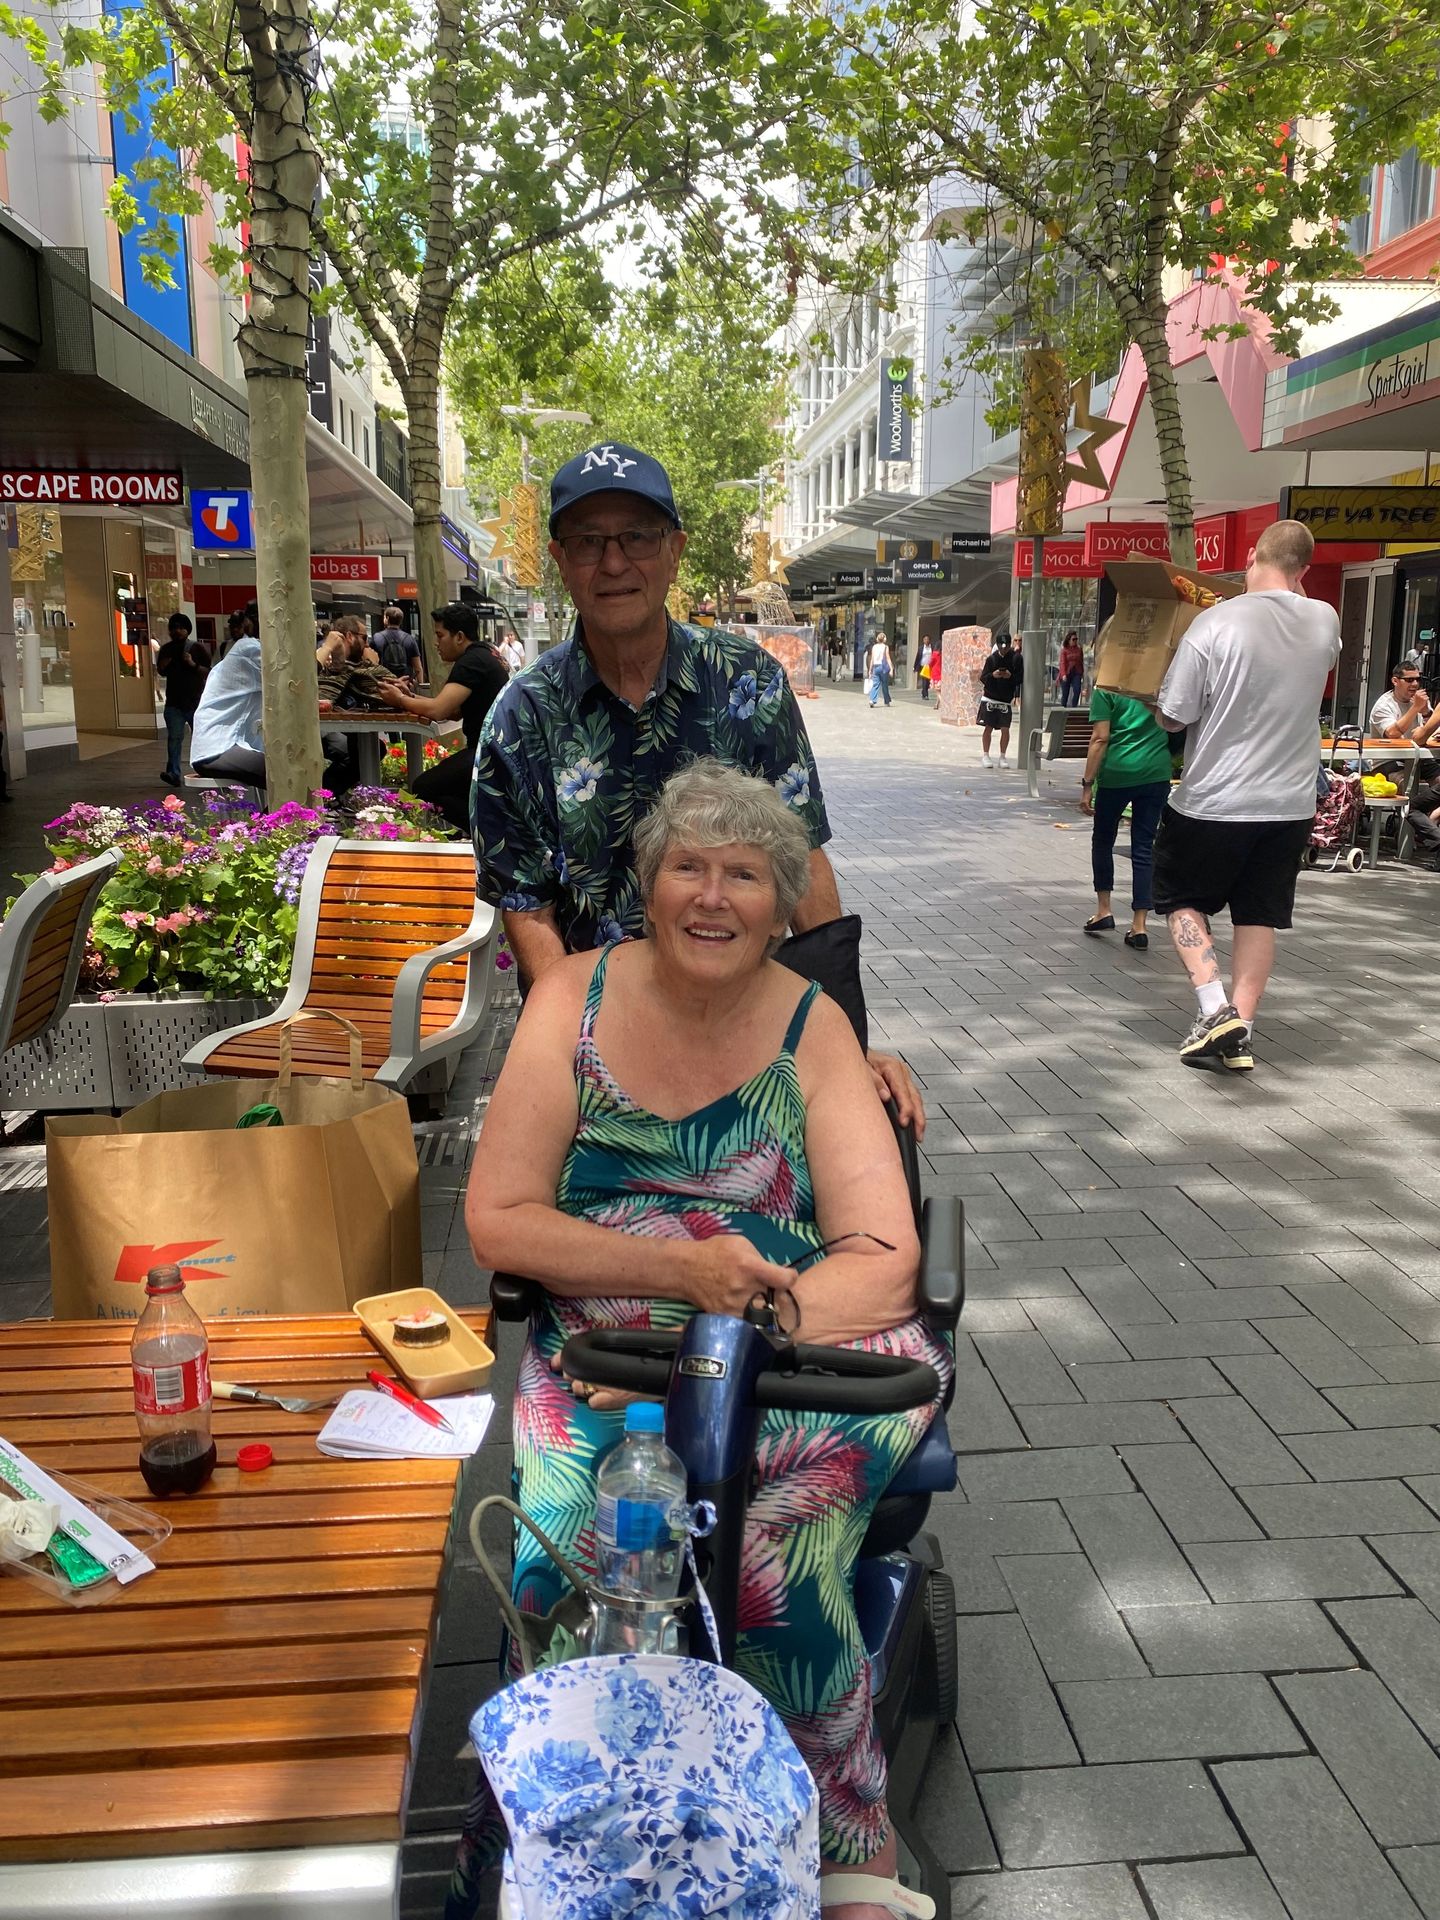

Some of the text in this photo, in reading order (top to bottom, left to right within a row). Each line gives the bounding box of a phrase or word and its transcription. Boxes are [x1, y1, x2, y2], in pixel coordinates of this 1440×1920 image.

[1365, 341, 1429, 408] Sportsgirl
[889, 384, 903, 454] woolworths
[580, 446, 637, 478] NY
[0, 474, 179, 500] SCAPE ROOMS
[208, 497, 239, 530] T
[1293, 506, 1438, 523] OFF YA TREE
[953, 539, 990, 547] michael hill
[1097, 536, 1169, 551] DYMOCK
[310, 559, 368, 578] ndbags
[907, 571, 935, 579] woolworths
